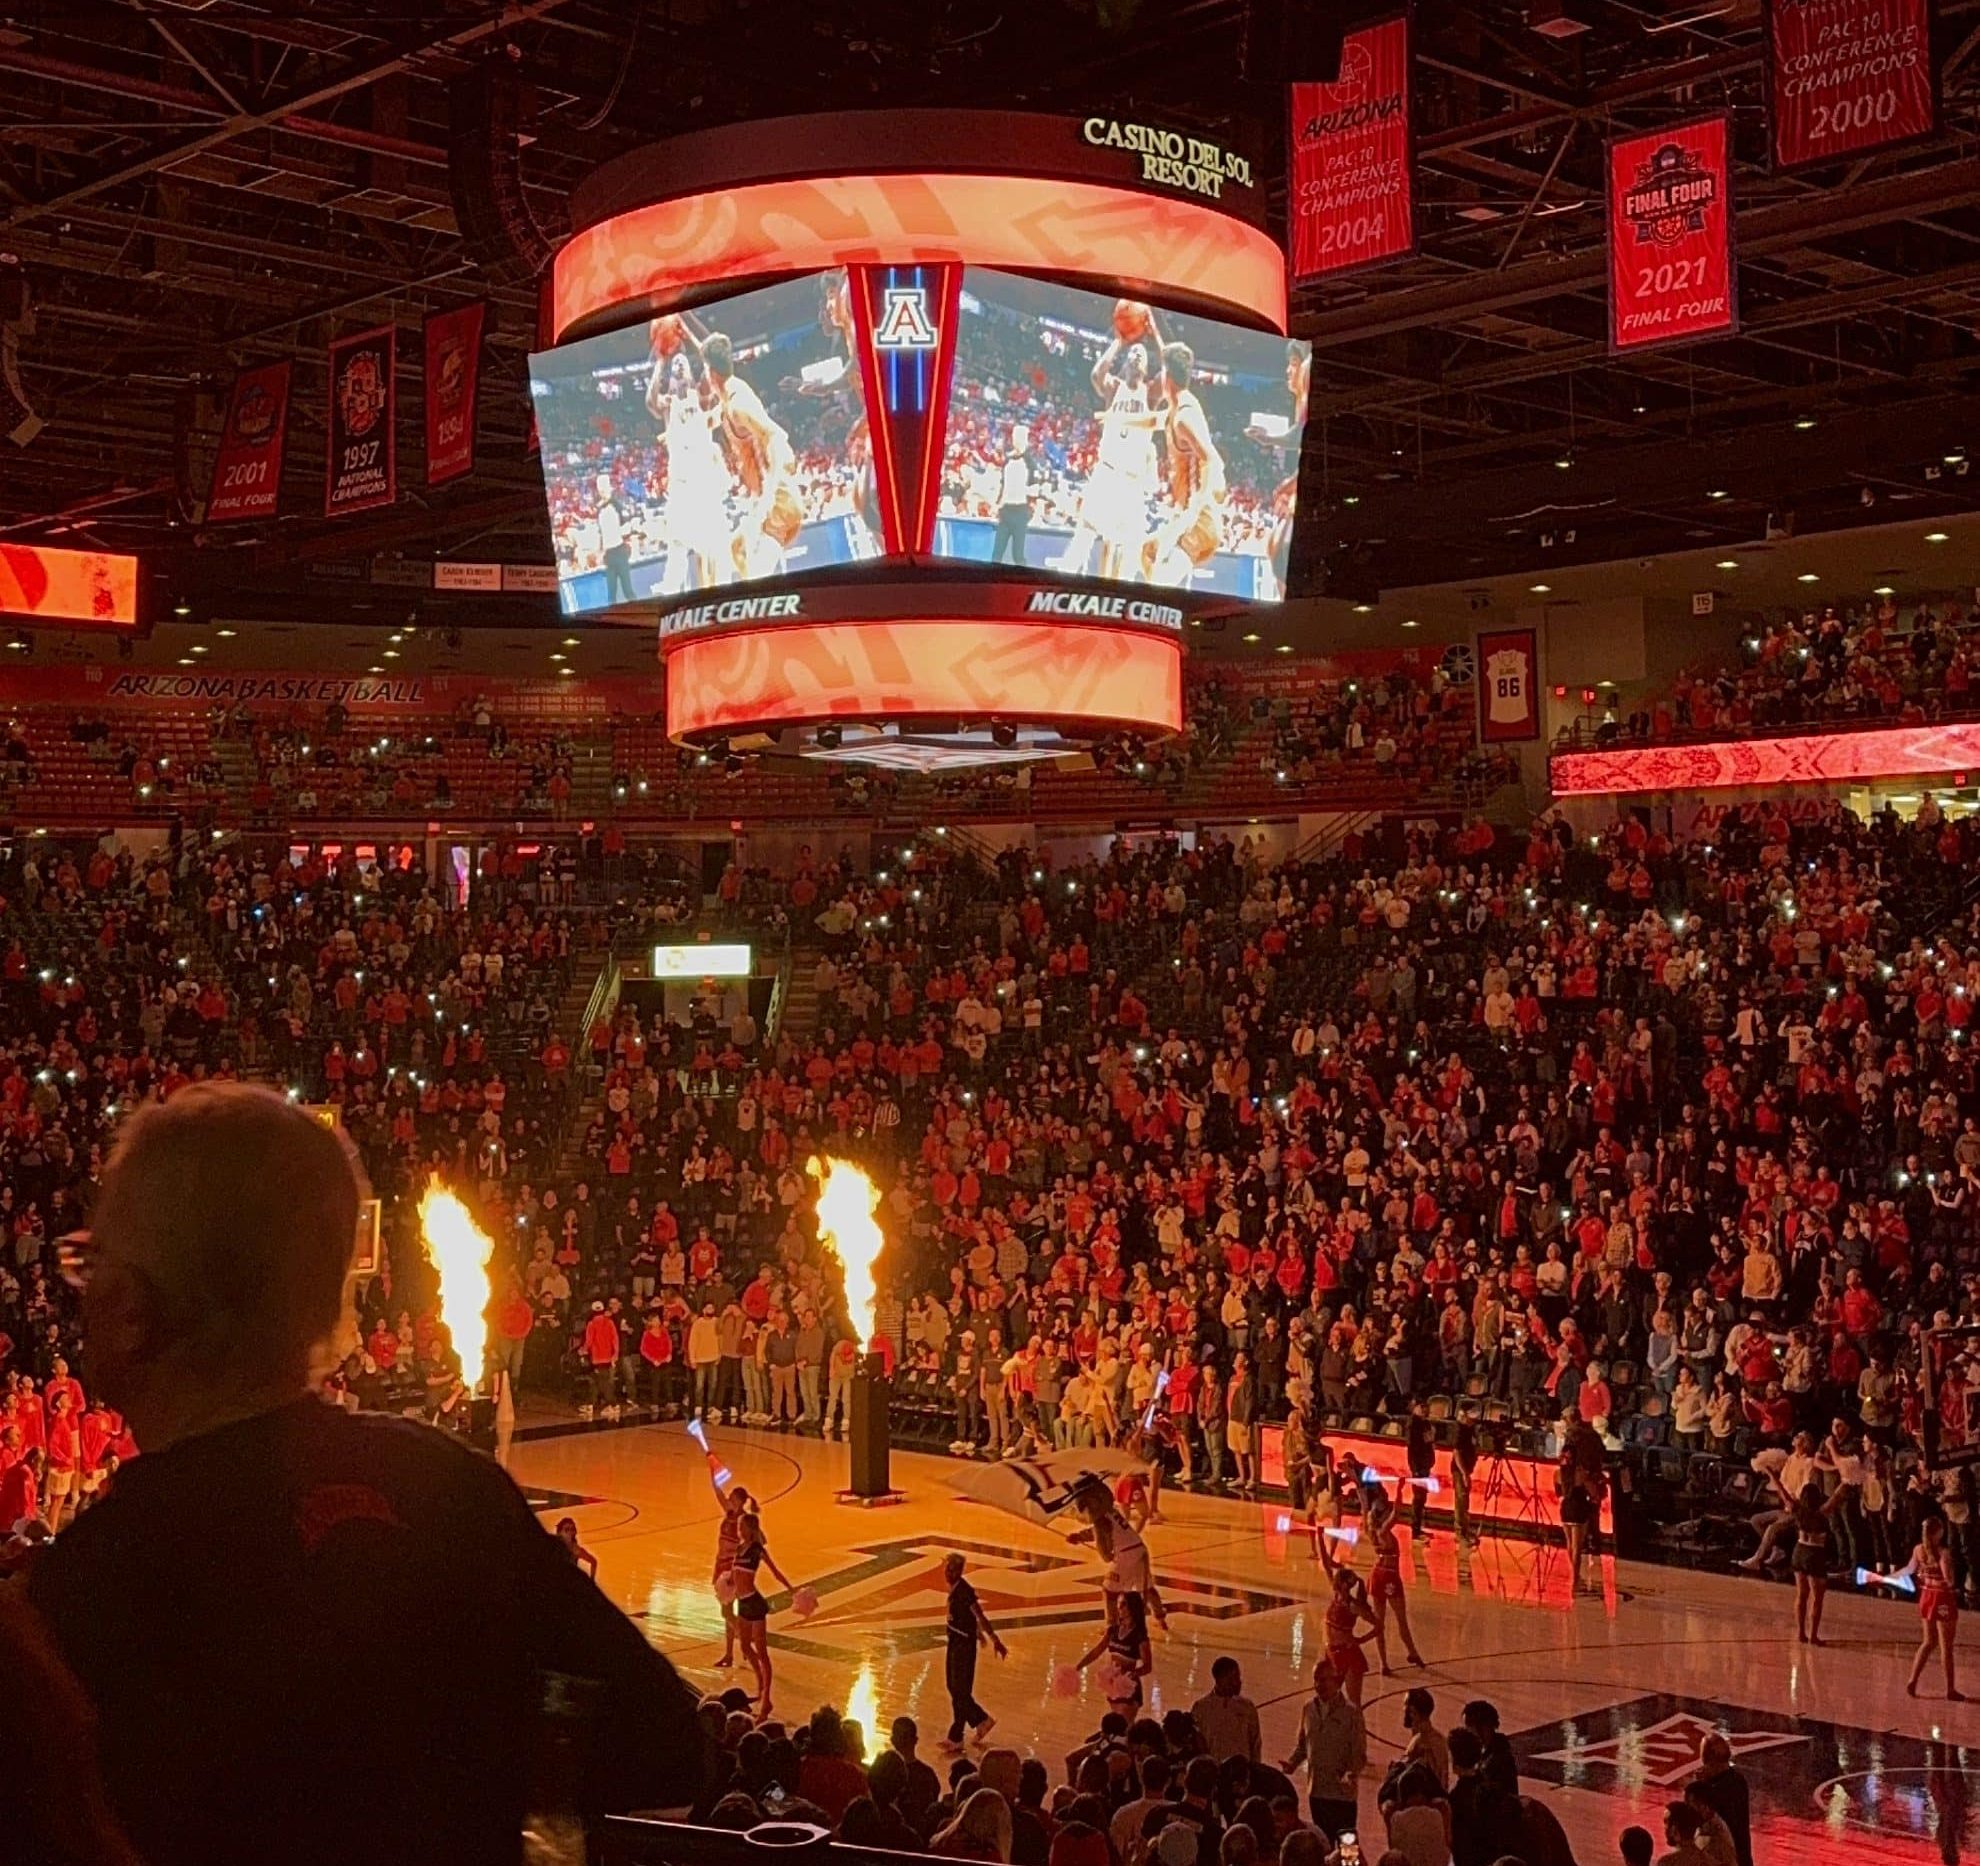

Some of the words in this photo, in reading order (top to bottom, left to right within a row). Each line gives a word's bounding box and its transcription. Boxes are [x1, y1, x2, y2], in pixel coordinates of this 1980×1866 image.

[1784, 24, 1918, 75] CONFERENCE
[1784, 47, 1919, 97] CHAMPIONS
[1302, 93, 1402, 140] ARIZONA
[1808, 88, 1897, 140] 2000
[1084, 118, 1184, 160] CASINO
[1187, 138, 1225, 174] DEL
[1225, 152, 1253, 188] SOL
[1142, 153, 1223, 198] RESORT
[1300, 158, 1400, 197] CONFERENCE
[1300, 178, 1400, 216] CHAMPIONS
[1626, 189, 1669, 215] FINAL
[1671, 179, 1713, 205] FOUR
[1320, 213, 1384, 253] 2004
[1635, 256, 1707, 298] 2021
[874, 289, 938, 348] A
[1622, 307, 1672, 330] FINAL
[1676, 297, 1724, 320] FOUR
[224, 461, 268, 487] 2001
[344, 440, 380, 470] 1997
[338, 466, 384, 488] NATIONAL
[716, 594, 800, 623] CENTER
[1029, 591, 1126, 618] MCKALE
[1128, 601, 1183, 629] CENTER
[1497, 677, 1520, 697] 86
